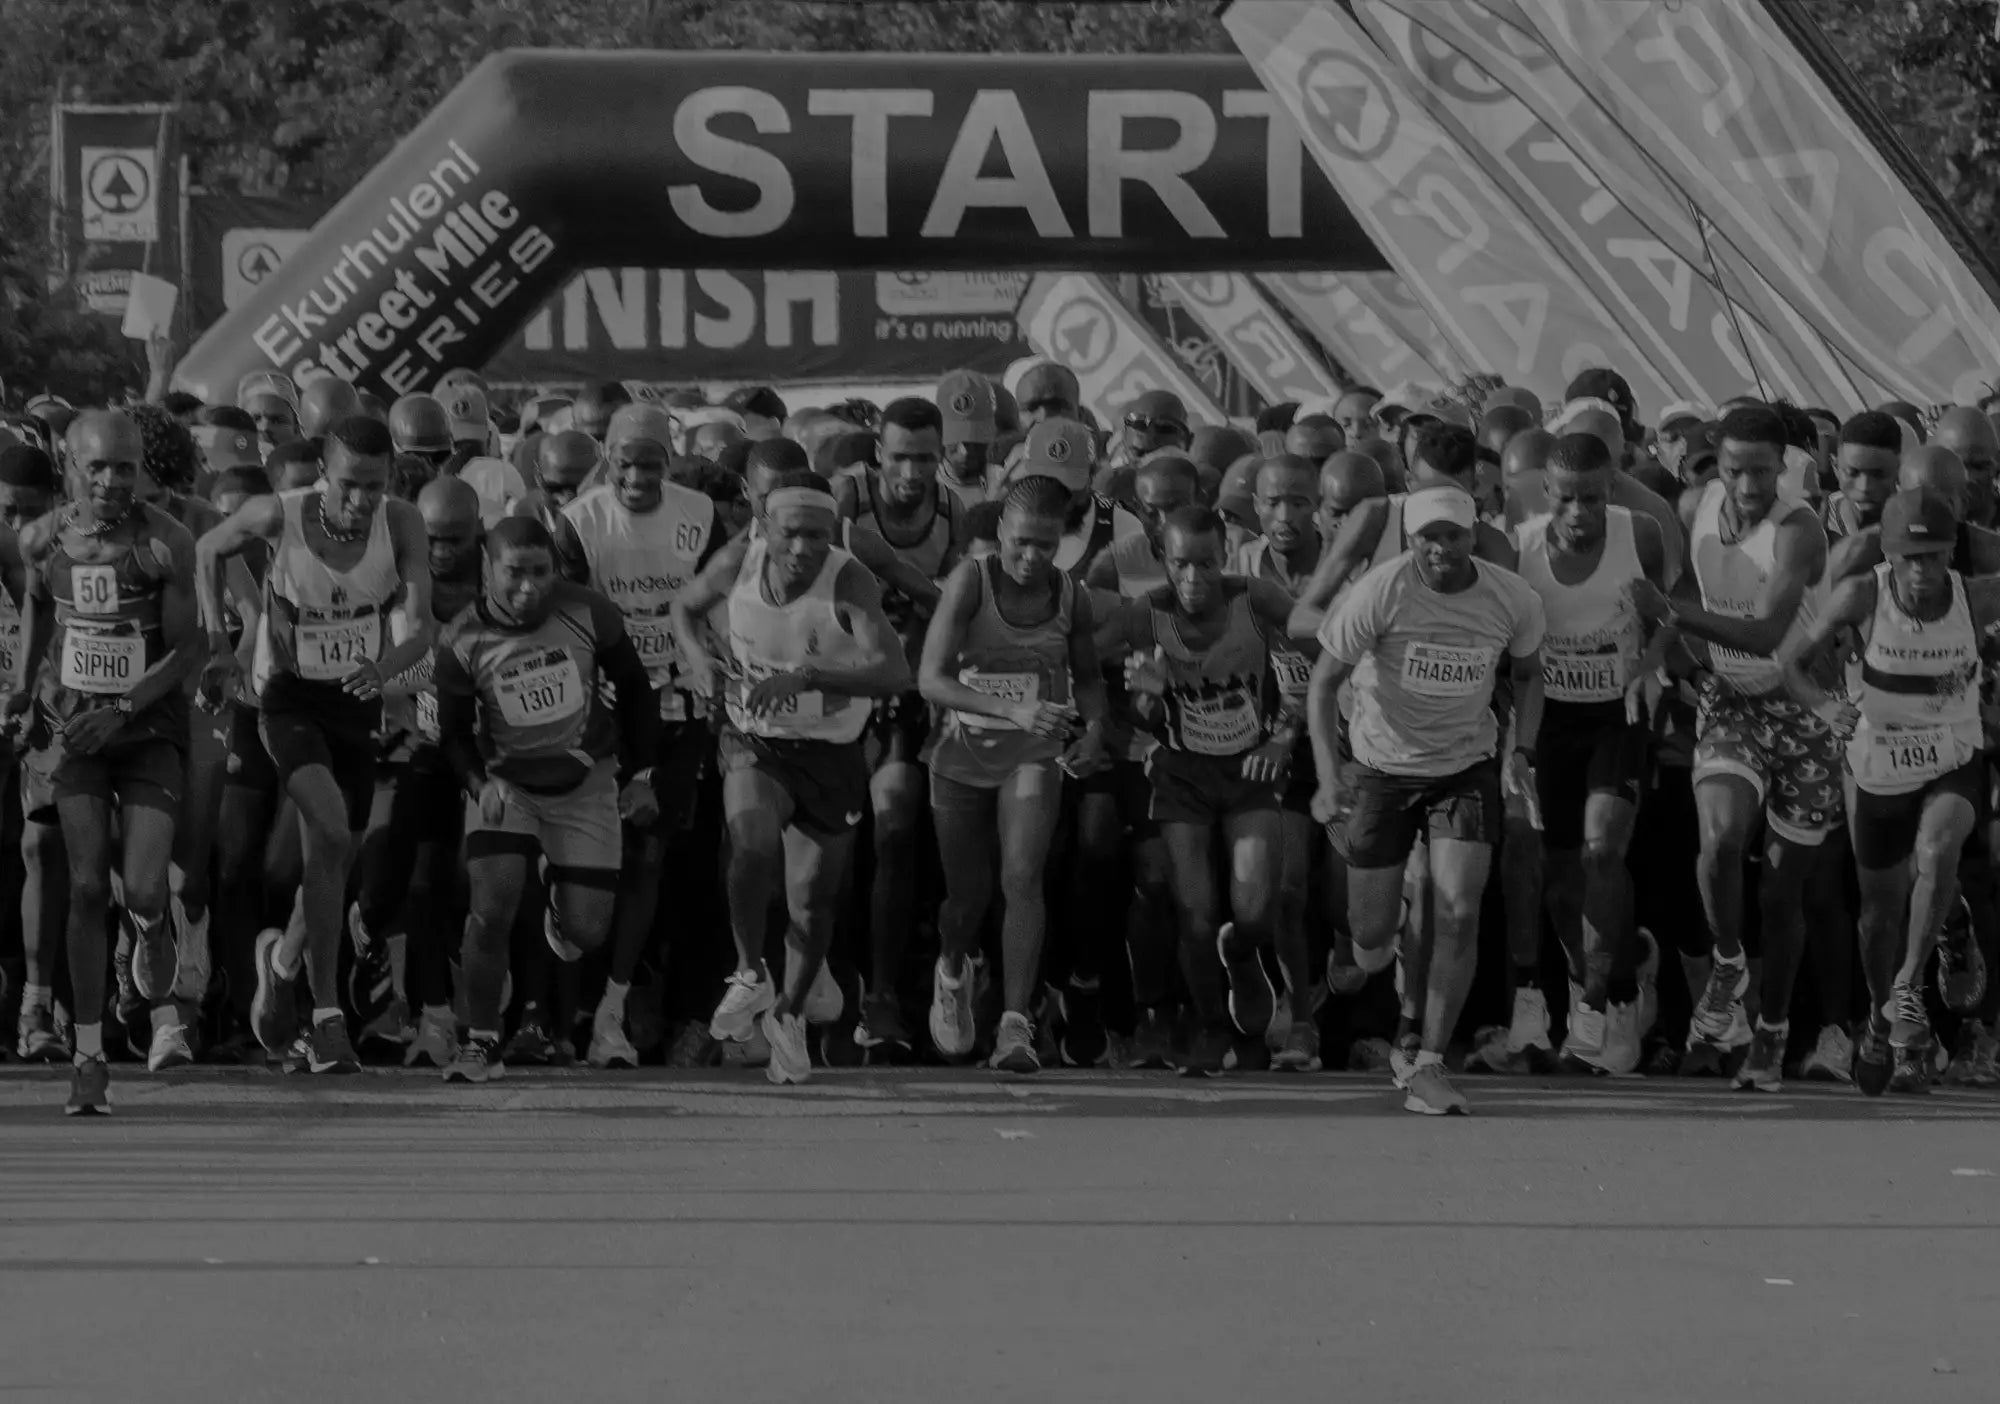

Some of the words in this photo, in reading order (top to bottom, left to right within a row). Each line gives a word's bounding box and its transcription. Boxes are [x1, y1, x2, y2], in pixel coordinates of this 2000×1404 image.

[667, 86, 1303, 238] START
[252, 139, 481, 368] Ekurhuleni
[414, 190, 519, 287] Mile
[379, 225, 556, 397] ERIES
[912, 320, 928, 341] a
[933, 315, 1013, 343] running
[80, 575, 108, 604] 50
[73, 650, 130, 679] SIPHO
[1542, 666, 1620, 690] SAMUEL
[519, 682, 564, 713] 1307
[1889, 744, 1939, 769] 1494
